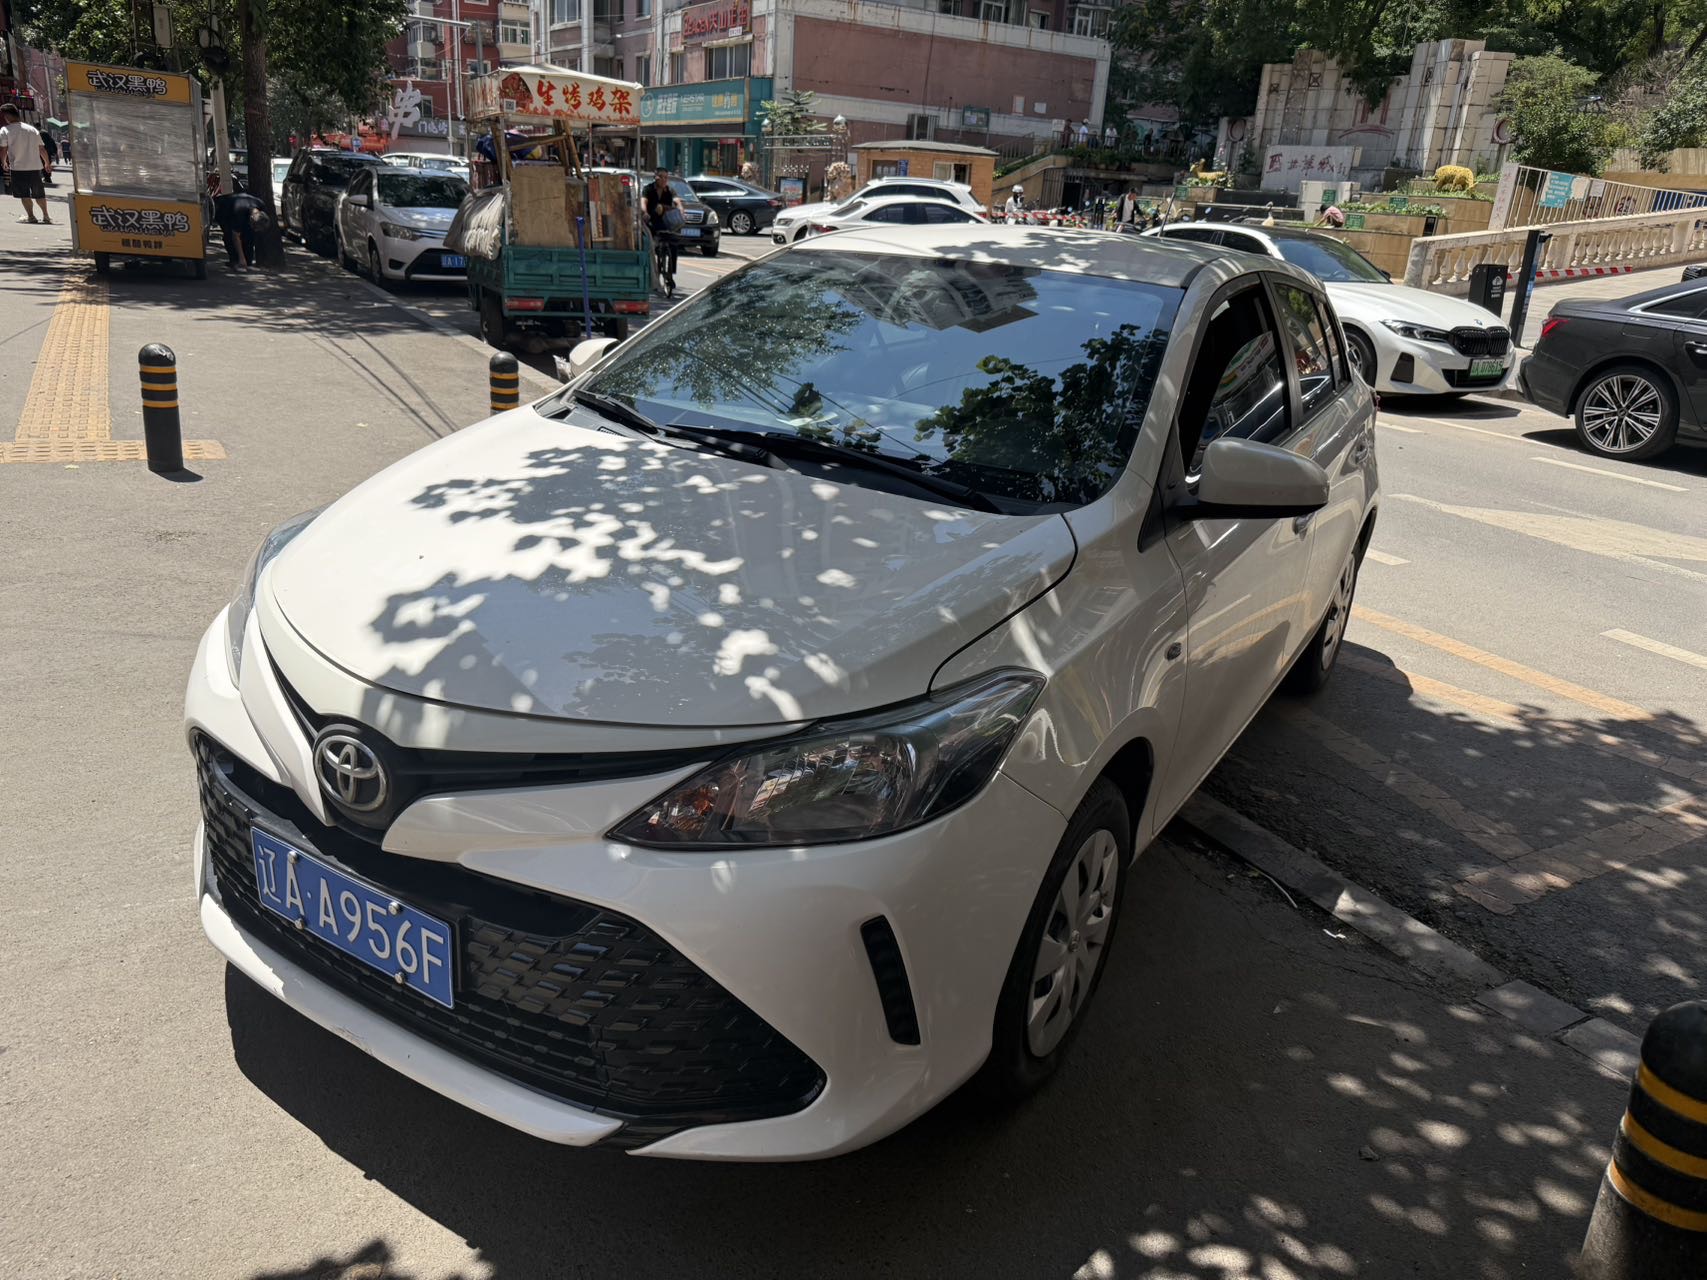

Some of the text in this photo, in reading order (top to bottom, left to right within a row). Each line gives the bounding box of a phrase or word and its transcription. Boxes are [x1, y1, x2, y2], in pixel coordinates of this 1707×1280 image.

[87, 70, 168, 95] 武汉黑鸭
[537, 79, 633, 115] 生烤鸡架
[90, 205, 190, 232] 武汉黑鸭
